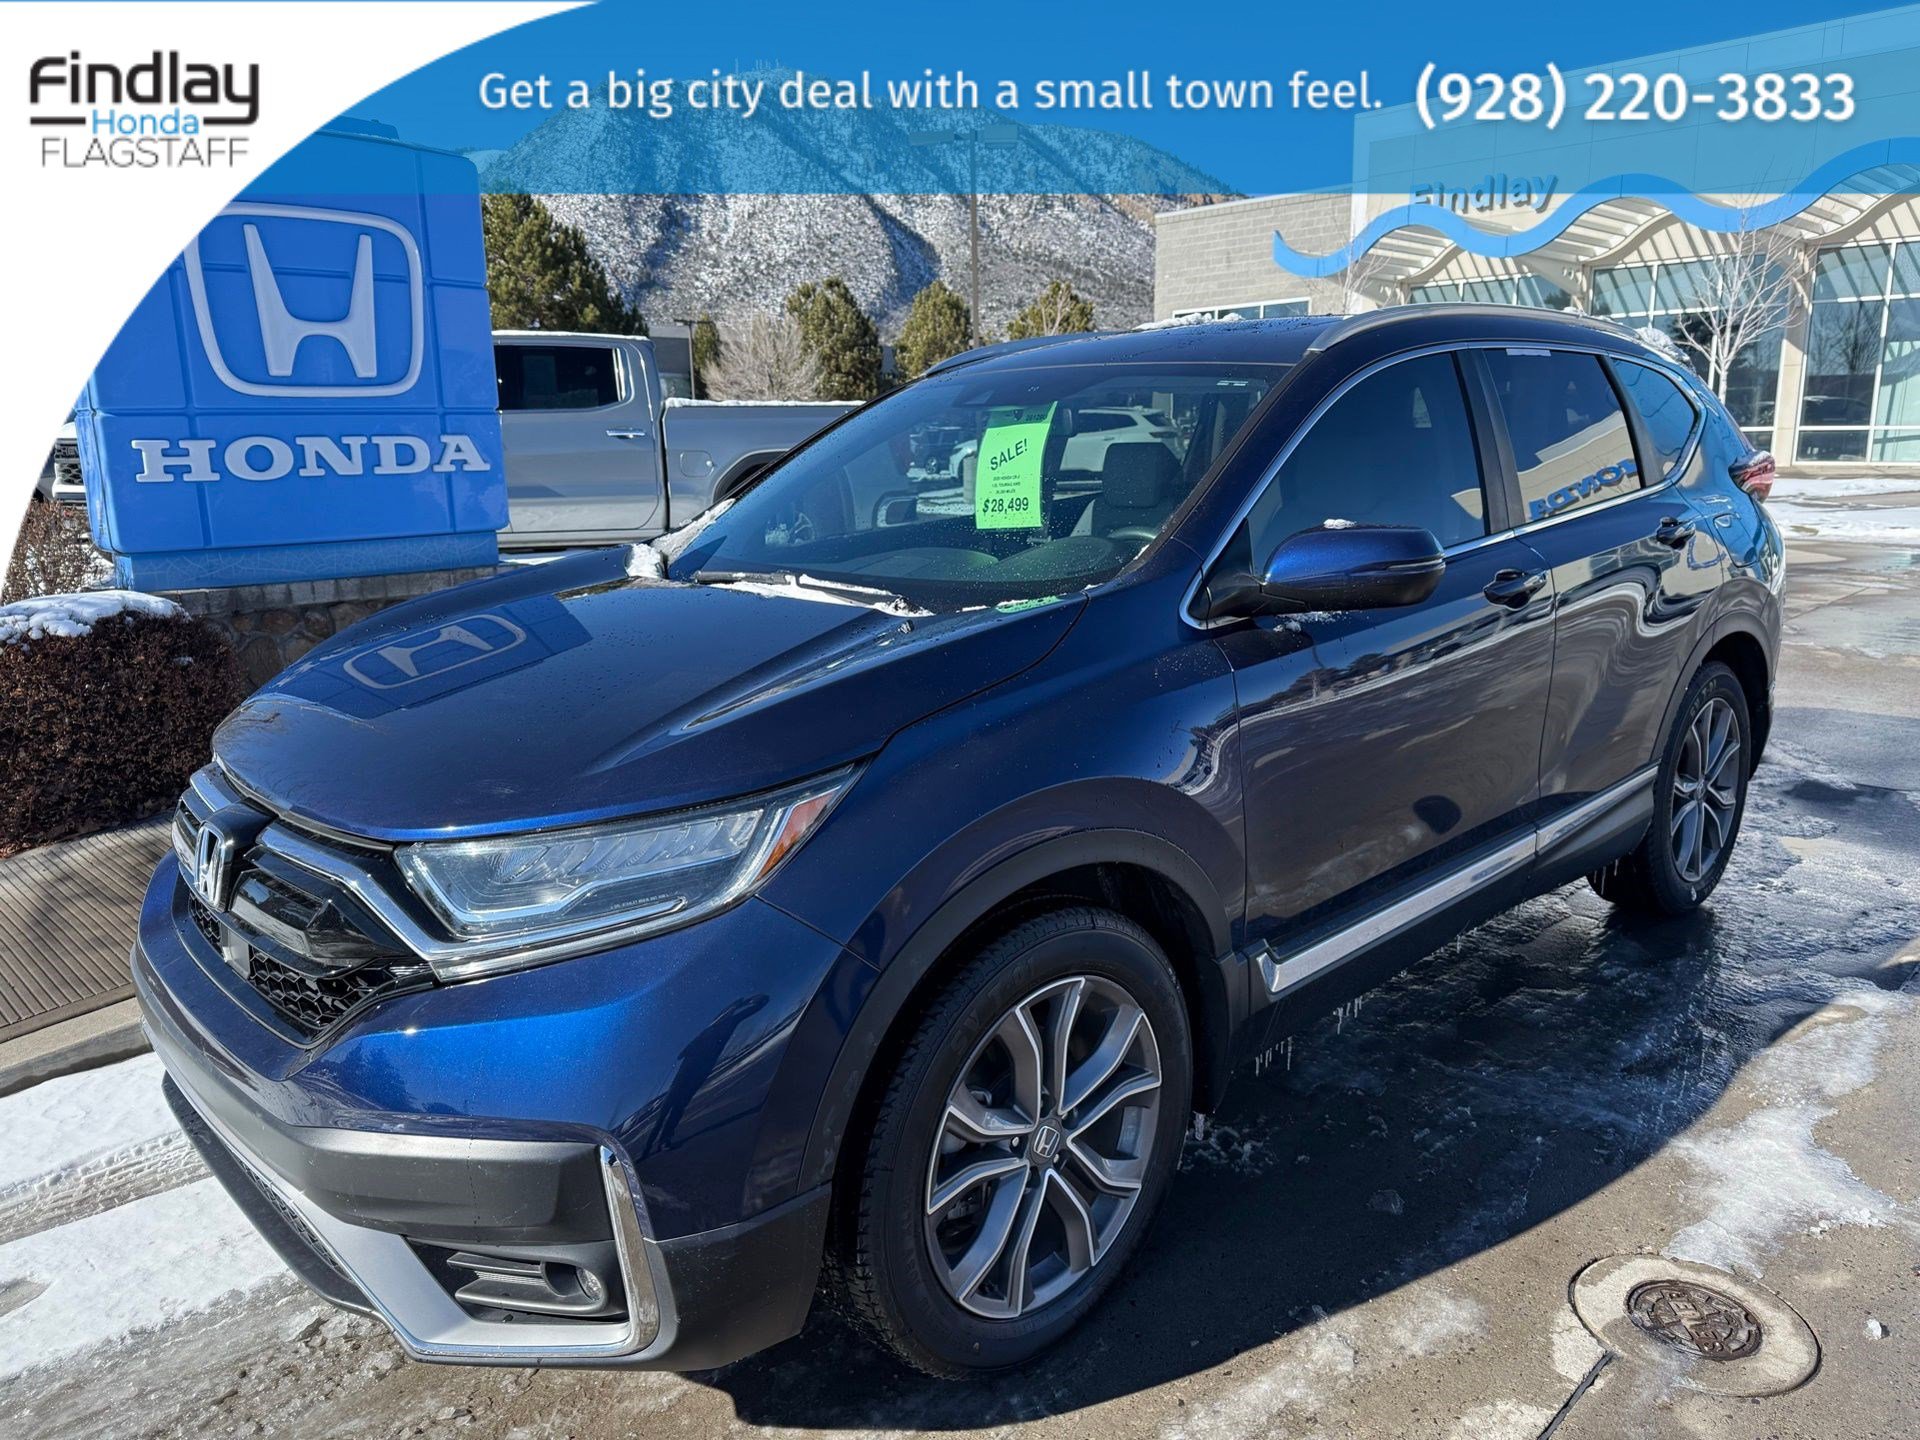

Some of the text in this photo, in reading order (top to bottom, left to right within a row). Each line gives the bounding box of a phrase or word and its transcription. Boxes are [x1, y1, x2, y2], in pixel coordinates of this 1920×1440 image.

[1410, 172, 1558, 214] Findlay
[132, 434, 490, 484] HONDA
[990, 438, 1028, 471] SALE!
[982, 497, 1029, 516] $28,499
